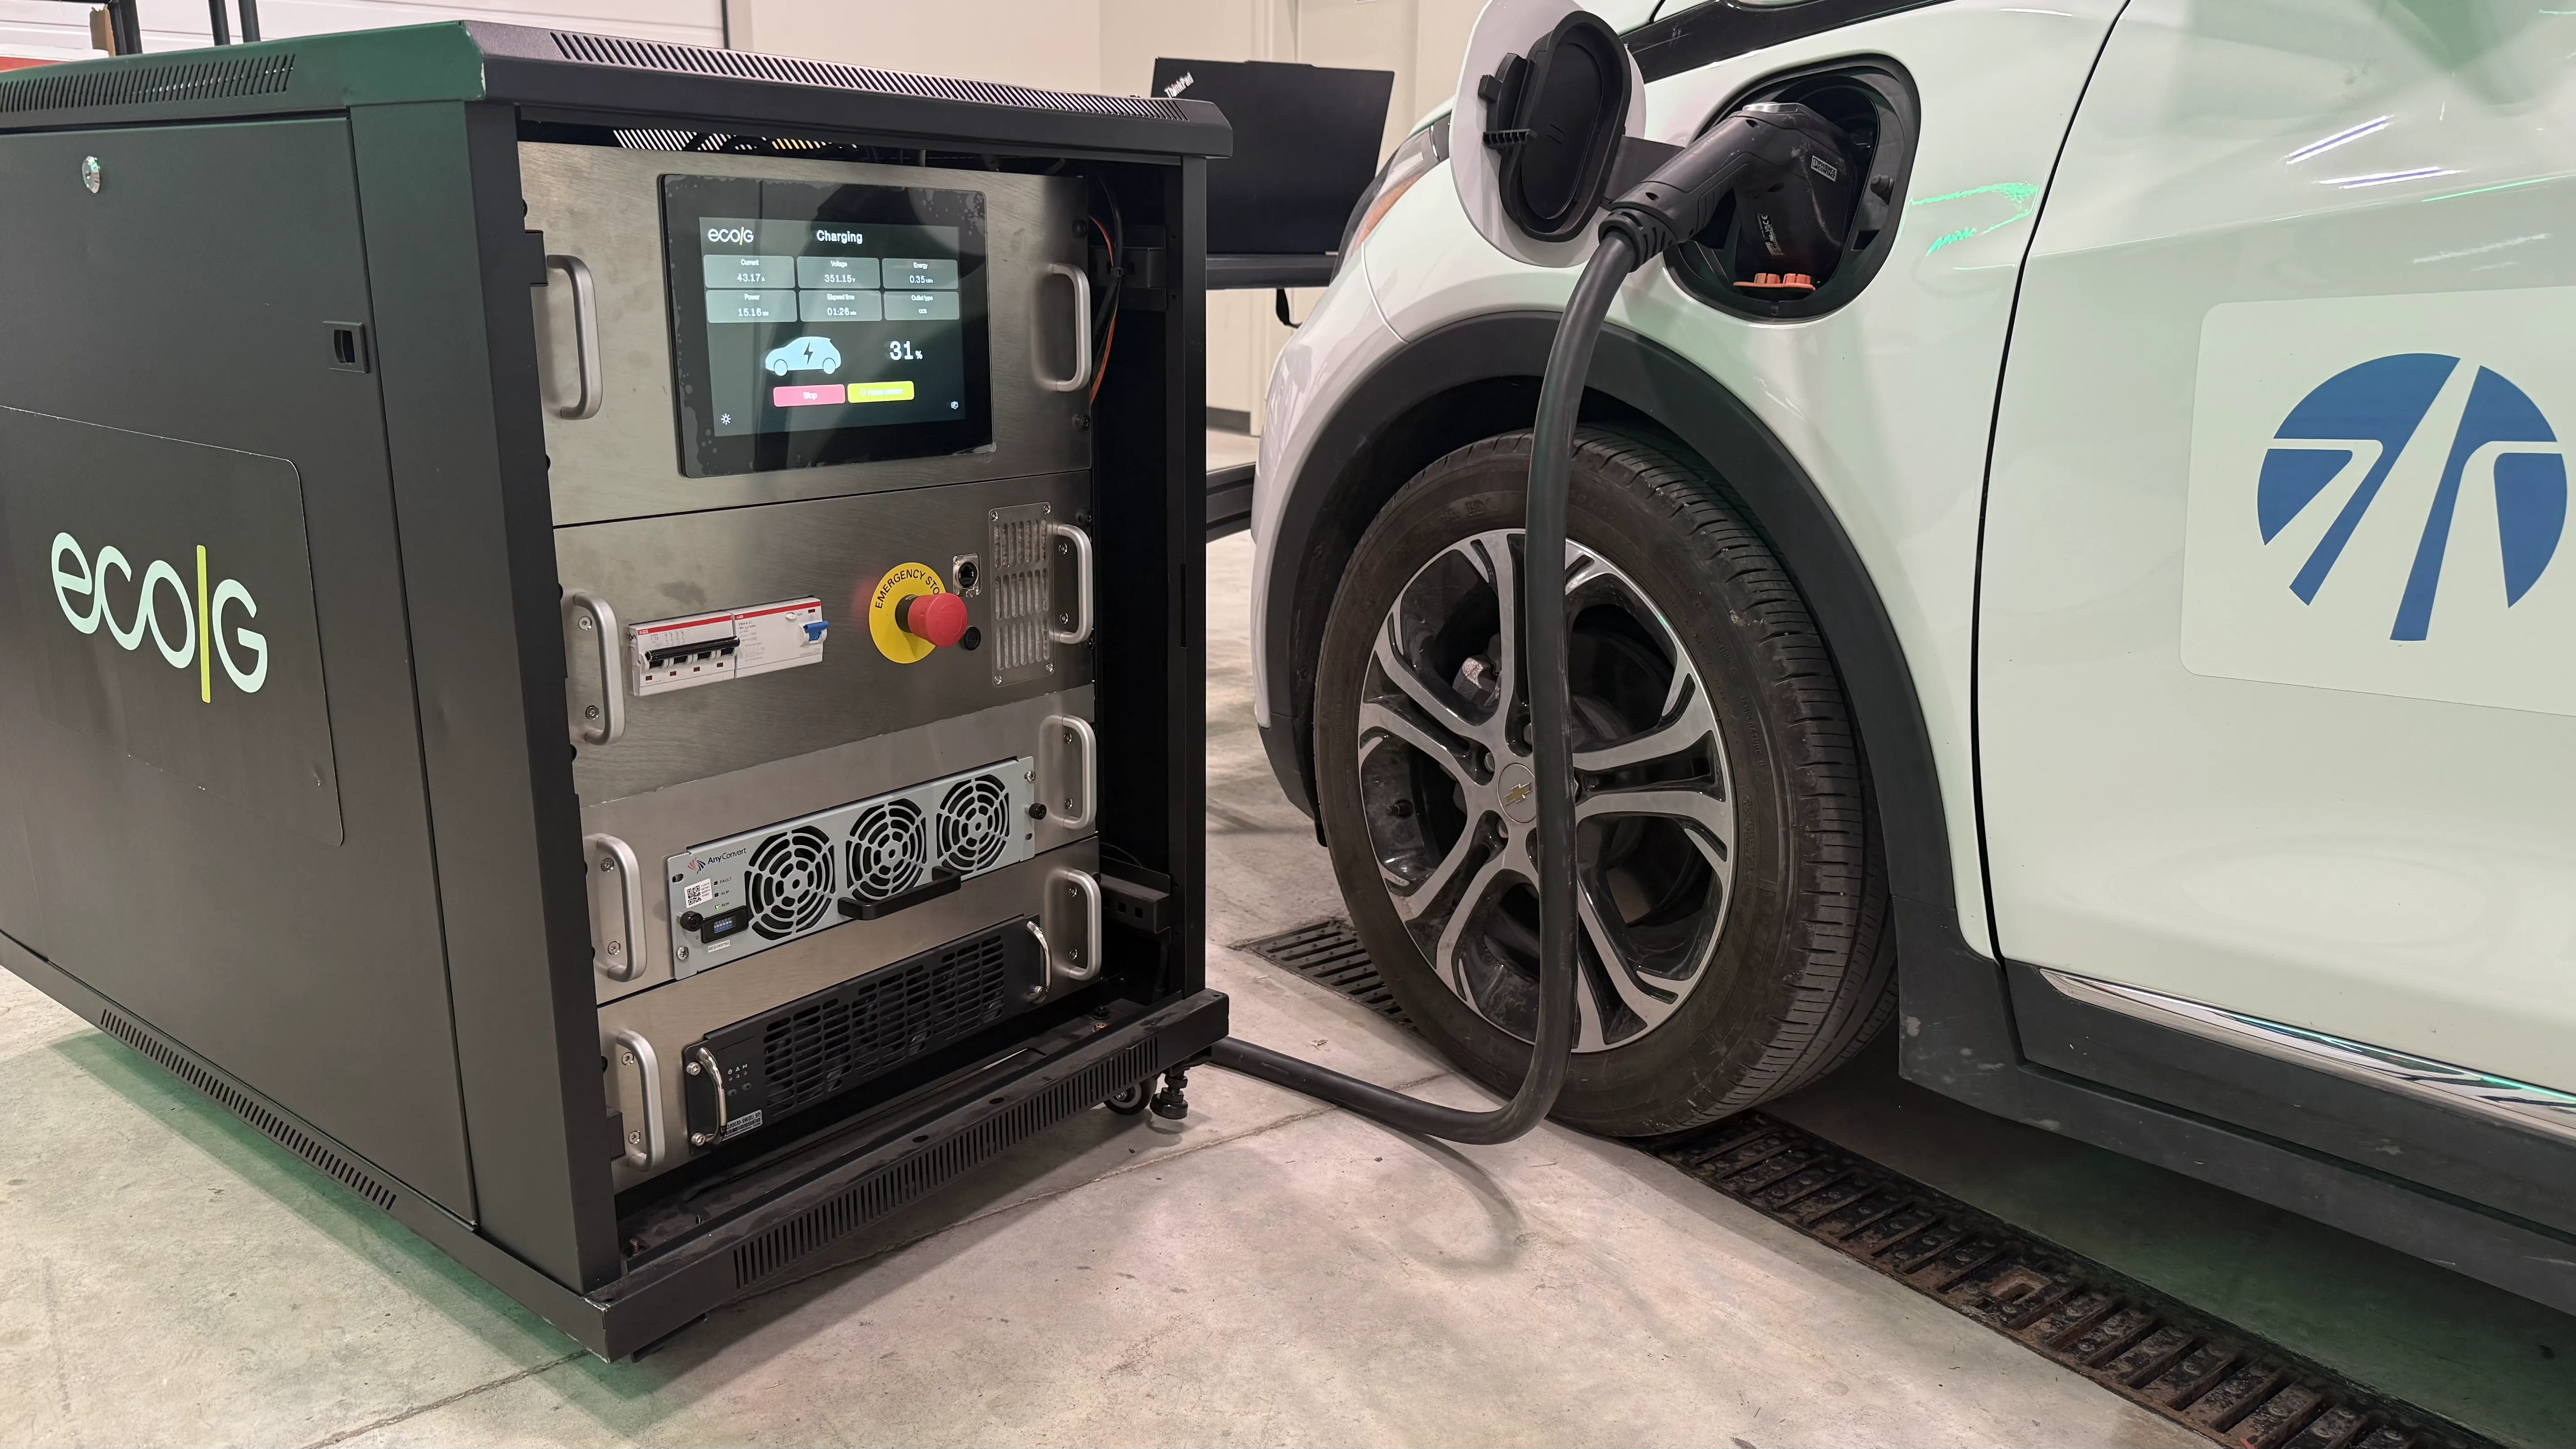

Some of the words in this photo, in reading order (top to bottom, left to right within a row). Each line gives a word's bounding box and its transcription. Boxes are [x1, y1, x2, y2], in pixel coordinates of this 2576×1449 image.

[816, 230, 863, 244] Charging
[803, 391, 818, 400] Stop
[875, 569, 925, 609] EMERGENCY
[925, 576, 940, 595] STO
